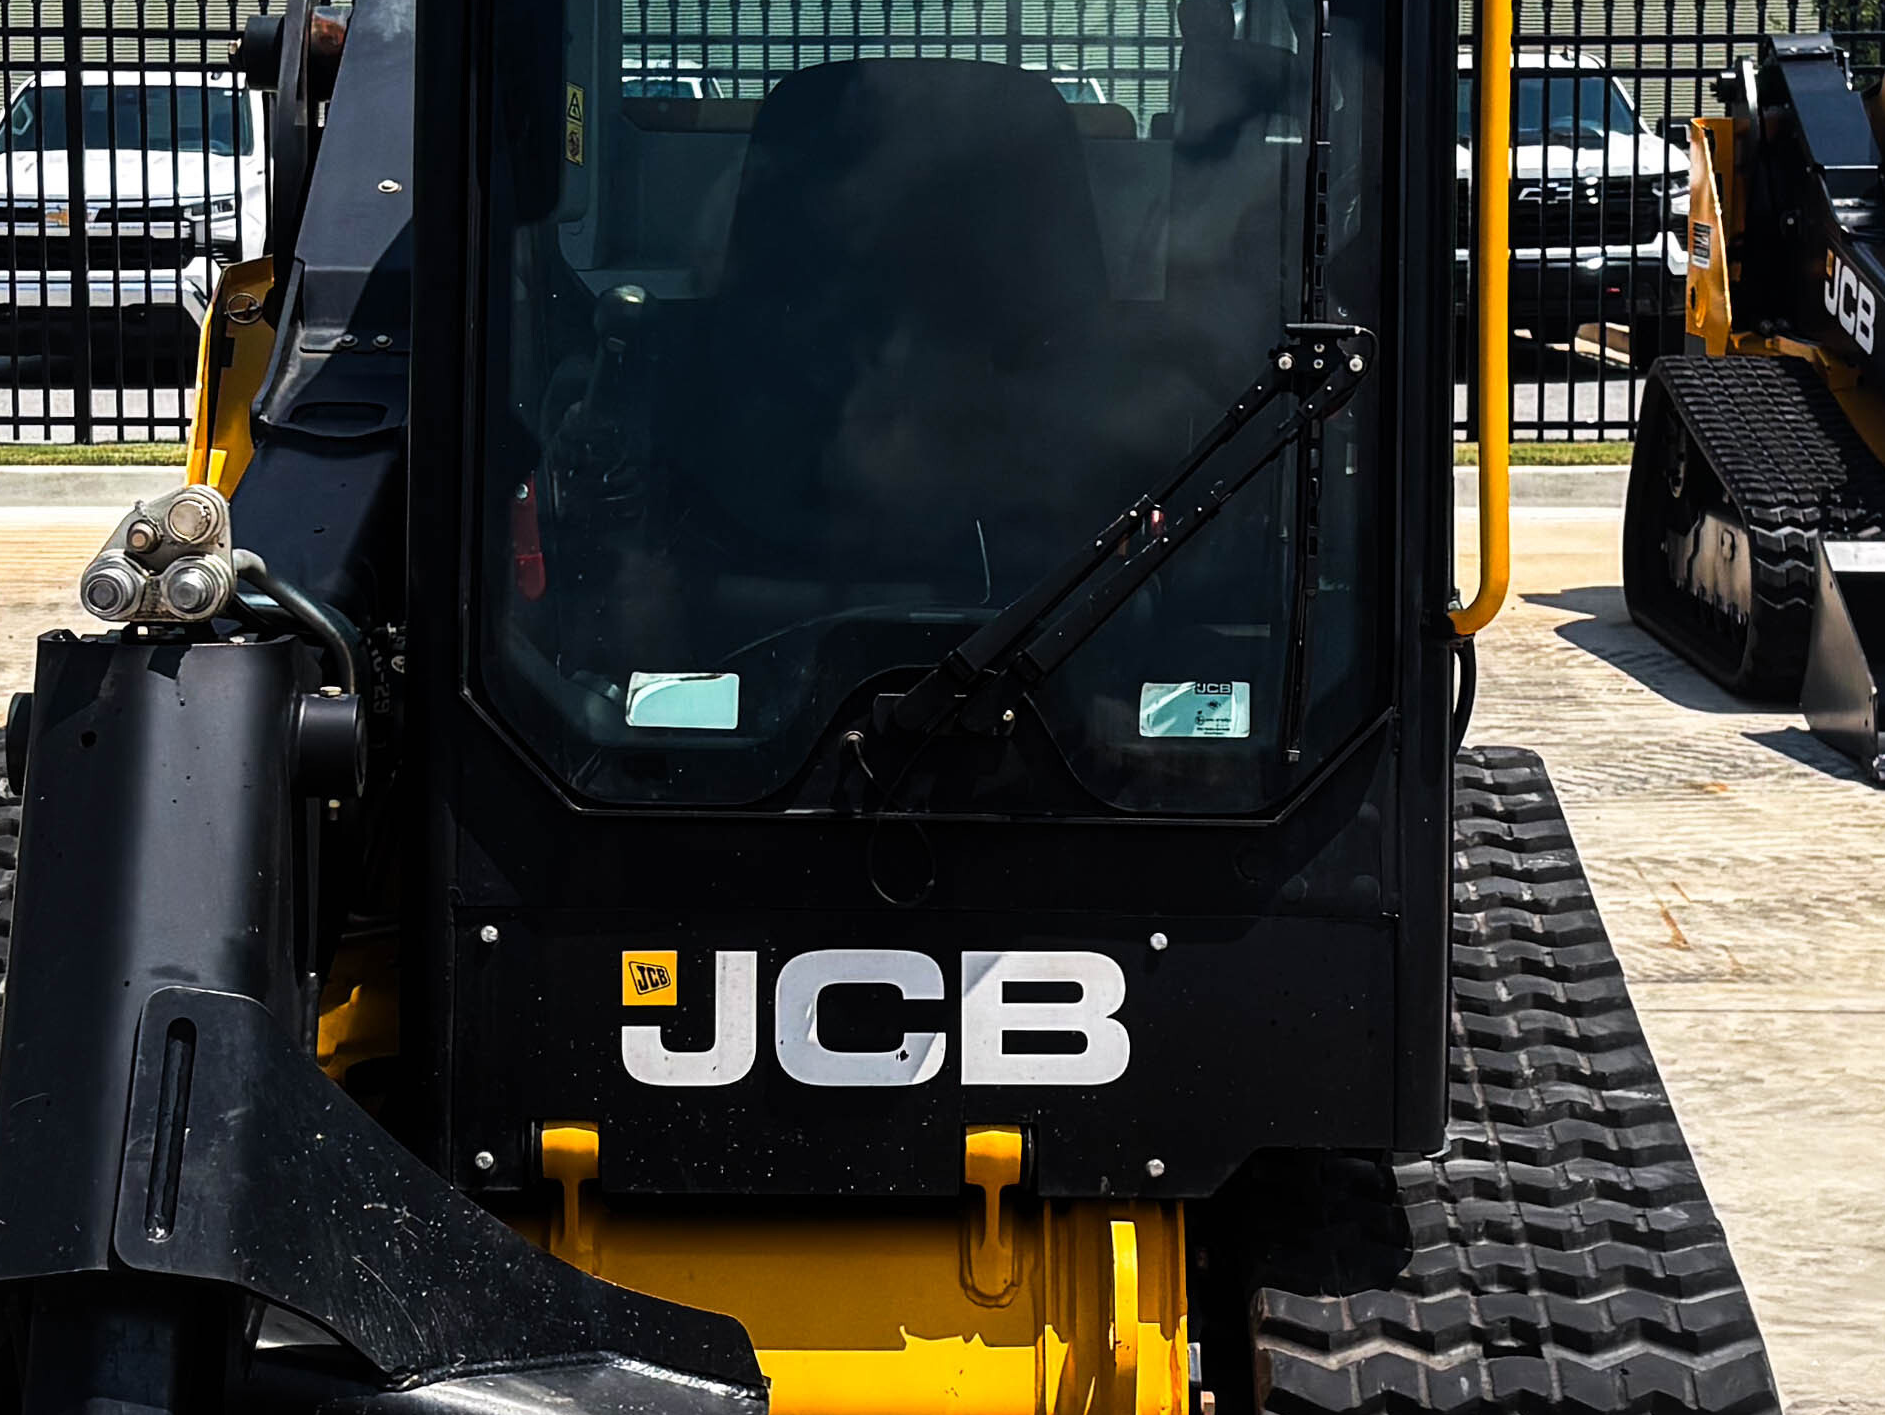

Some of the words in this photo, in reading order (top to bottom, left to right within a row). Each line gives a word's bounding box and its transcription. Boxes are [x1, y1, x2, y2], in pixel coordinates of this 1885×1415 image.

[1824, 256, 1875, 355] JCB
[1197, 683, 1231, 693] JCB
[636, 965, 668, 991] JCB
[622, 949, 1130, 1086] JCB
